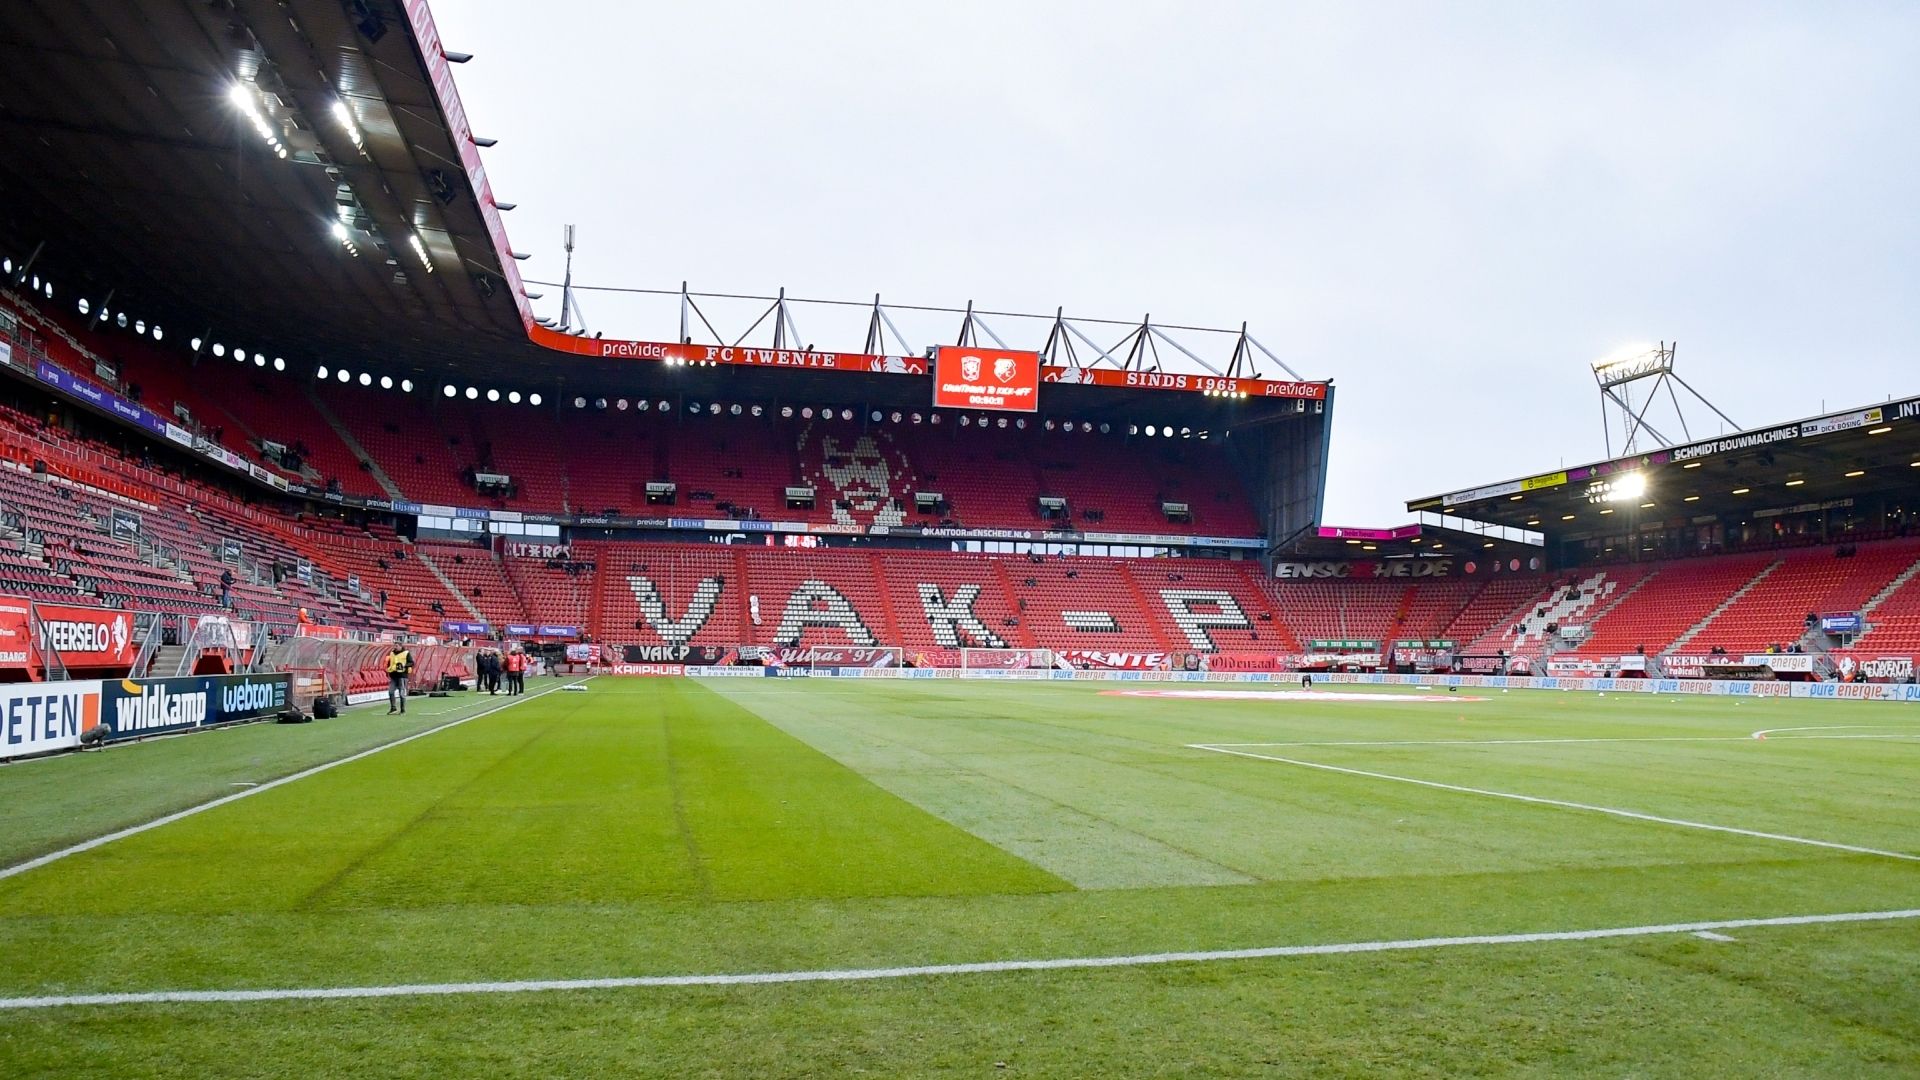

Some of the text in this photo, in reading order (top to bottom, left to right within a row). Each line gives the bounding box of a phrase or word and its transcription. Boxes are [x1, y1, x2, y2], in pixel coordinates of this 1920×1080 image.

[603, 342, 667, 357] previder
[705, 347, 835, 367] FC TWENTE
[1127, 373, 1238, 392] SINDS 1965
[1266, 382, 1319, 397] previder
[1674, 426, 1798, 461] SCHMIDT BOUWMACHINES
[523, 514, 553, 522] previder
[637, 518, 666, 527] previder
[38, 620, 109, 652] WEERSELO
[640, 646, 690, 661] VAK-P
[780, 648, 843, 663] Ultras
[1211, 655, 1276, 669] Oldenzaal
[1663, 656, 1707, 666] NEEDE
[1771, 657, 1807, 668] energie
[613, 665, 682, 675] KAMPHUIS
[776, 667, 832, 678] wildkamp
[913, 668, 933, 678] pure
[1053, 670, 1106, 681] pure energie
[1121, 671, 1172, 682] pure energie
[1187, 672, 1236, 682] pure energie
[1250, 673, 1299, 683] pure energie
[1331, 674, 1359, 684] energie
[1558, 679, 1584, 690] energie
[1597, 680, 1643, 692] pure energie
[1659, 680, 1712, 693] pure energie
[1729, 682, 1791, 695] pure energie
[223, 678, 272, 712] webton
[1810, 684, 1882, 699] pure energie
[116, 684, 206, 732] wildkamp
[0, 694, 78, 744] ETEN
